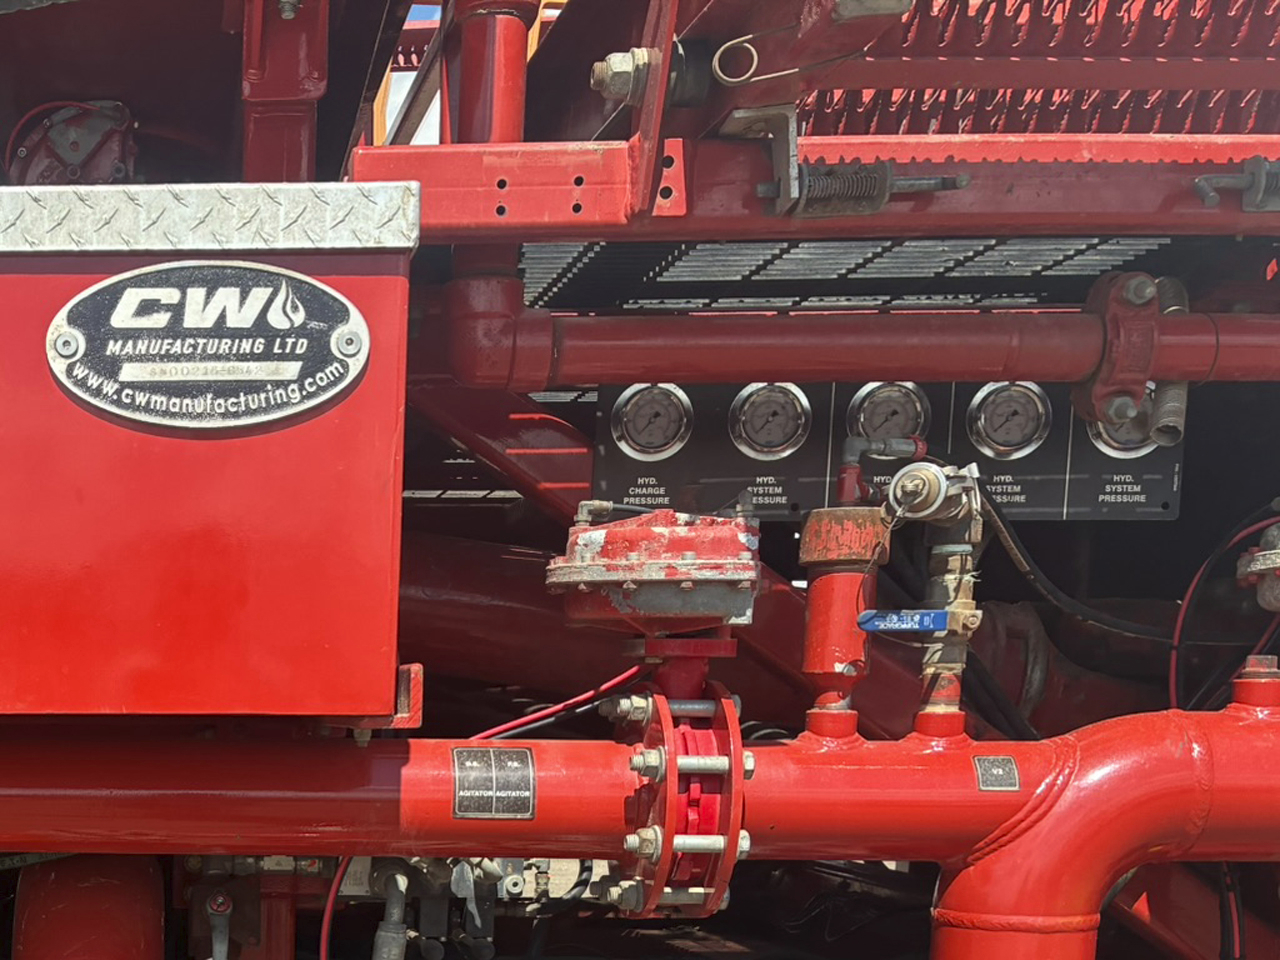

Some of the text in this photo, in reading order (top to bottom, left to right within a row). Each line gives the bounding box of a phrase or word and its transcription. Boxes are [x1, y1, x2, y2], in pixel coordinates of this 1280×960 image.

[109, 287, 273, 329] CW
[106, 338, 309, 356] MANUFACTURING LTD
[72, 361, 344, 414] www.cwmanufacturing.com
[637, 477, 658, 485] HYD.
[756, 476, 776, 484] HYD.
[1113, 474, 1134, 482] HYD.
[1105, 484, 1141, 493] SYSTEM
[623, 497, 670, 505] PRESSURE
[1098, 494, 1146, 503] PRESSURE
